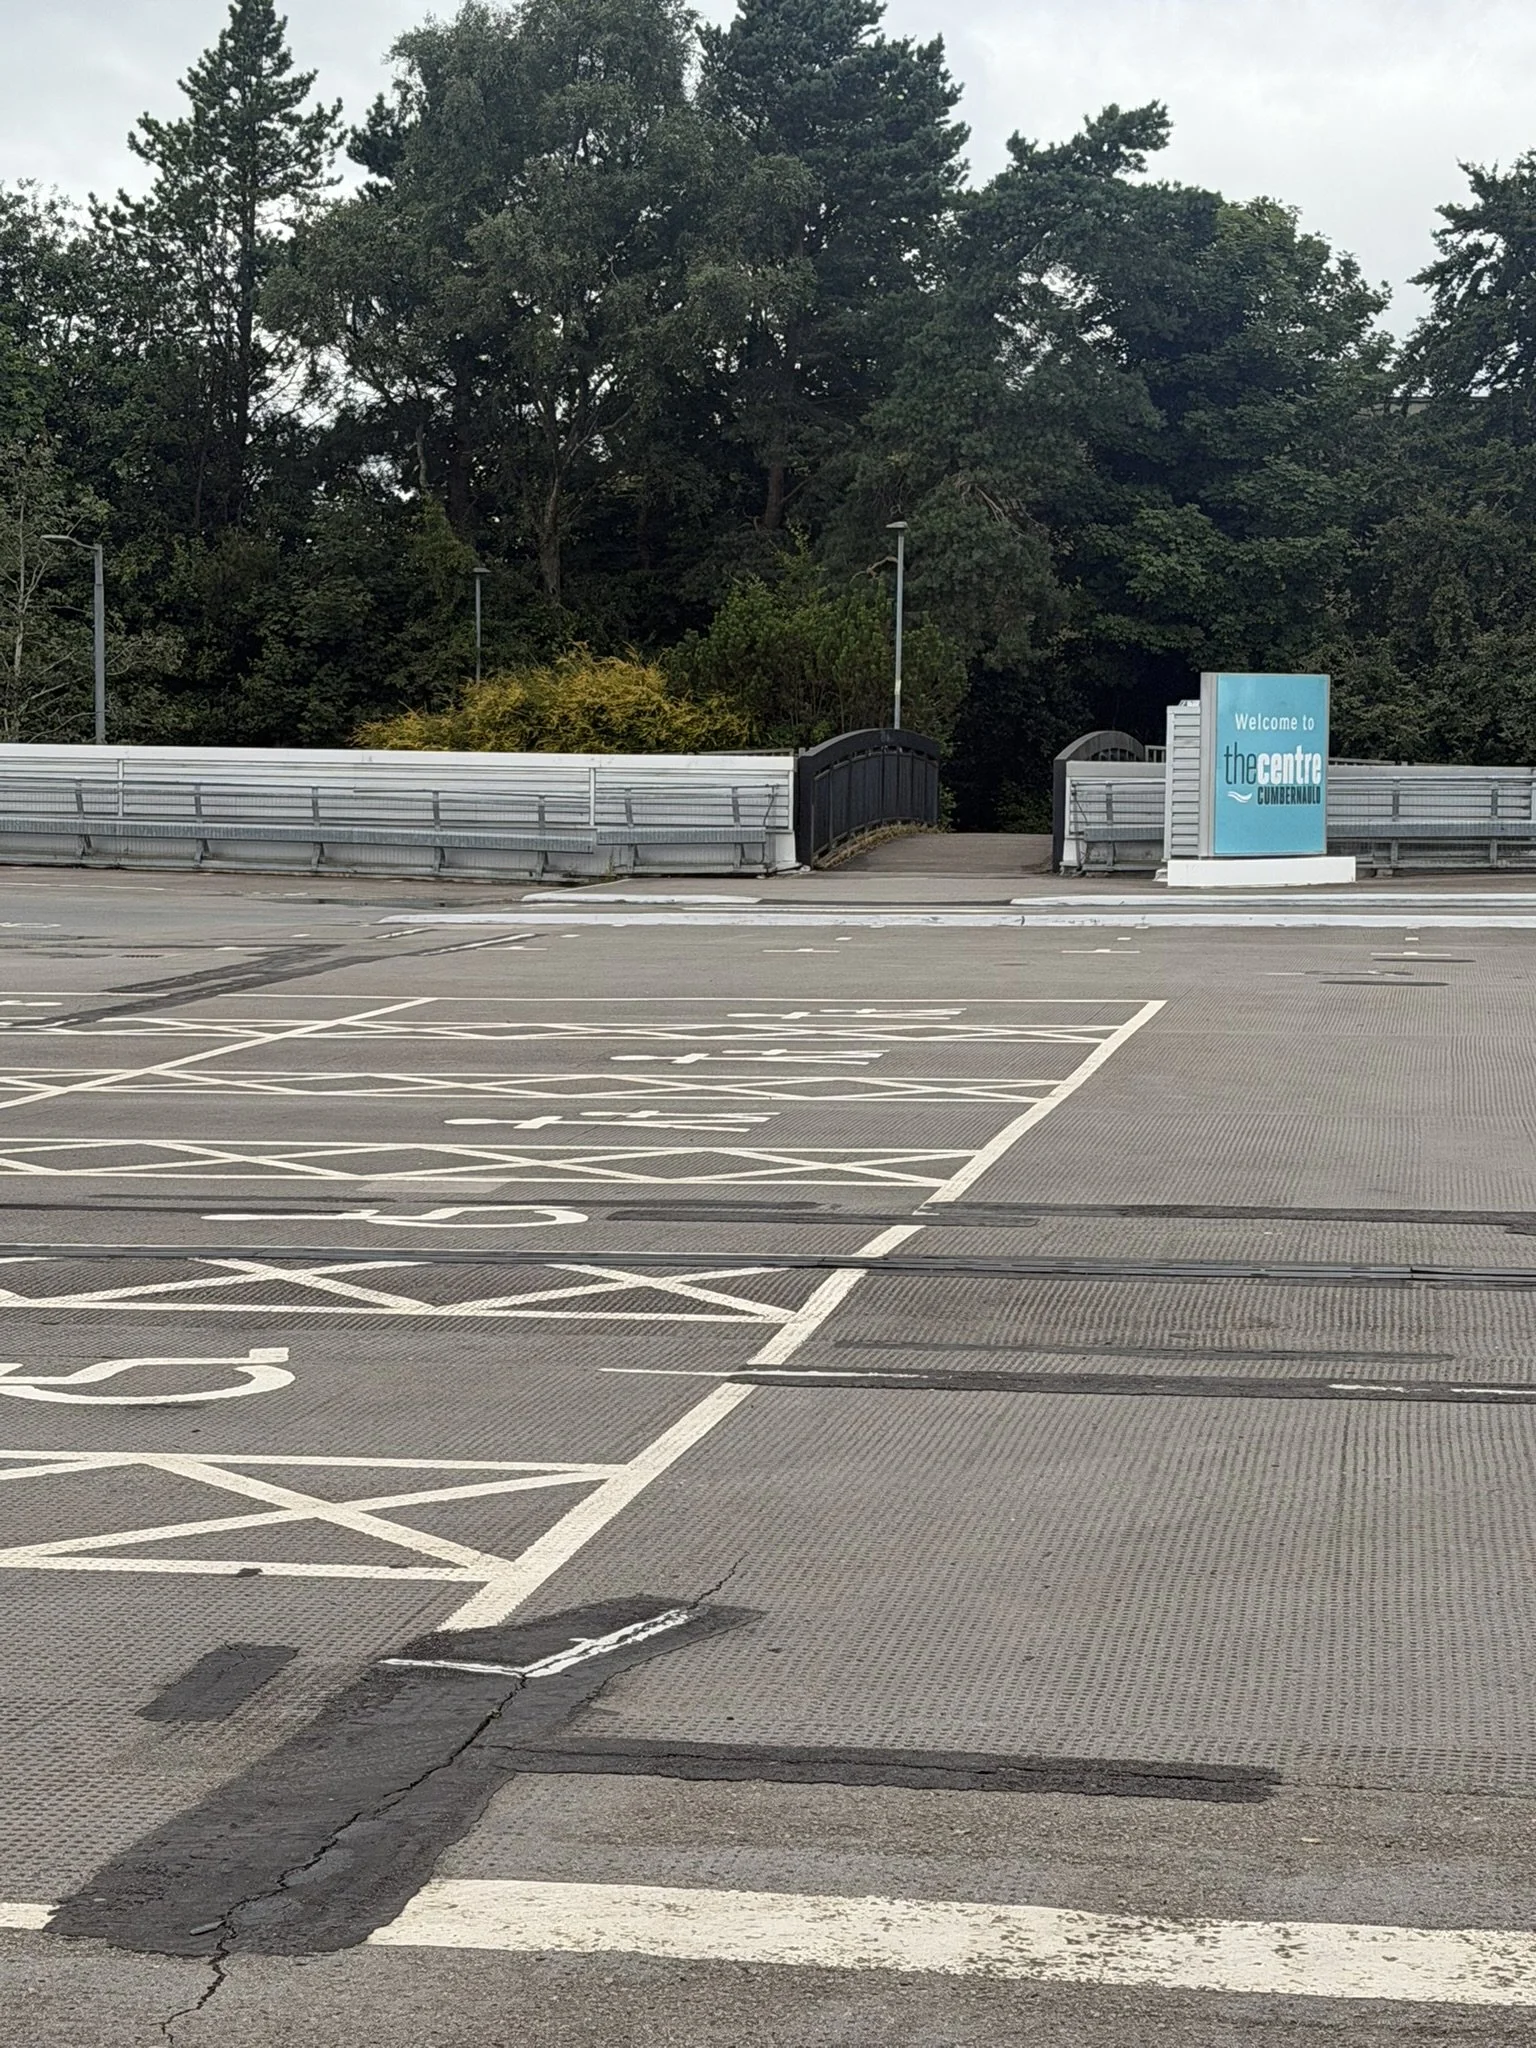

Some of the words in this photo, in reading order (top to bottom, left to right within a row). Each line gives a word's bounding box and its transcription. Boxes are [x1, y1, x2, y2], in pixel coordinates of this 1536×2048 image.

[1234, 712, 1298, 731] Welcome
[1302, 714, 1315, 731] to
[1257, 786, 1321, 805] CUMBERNAULD
